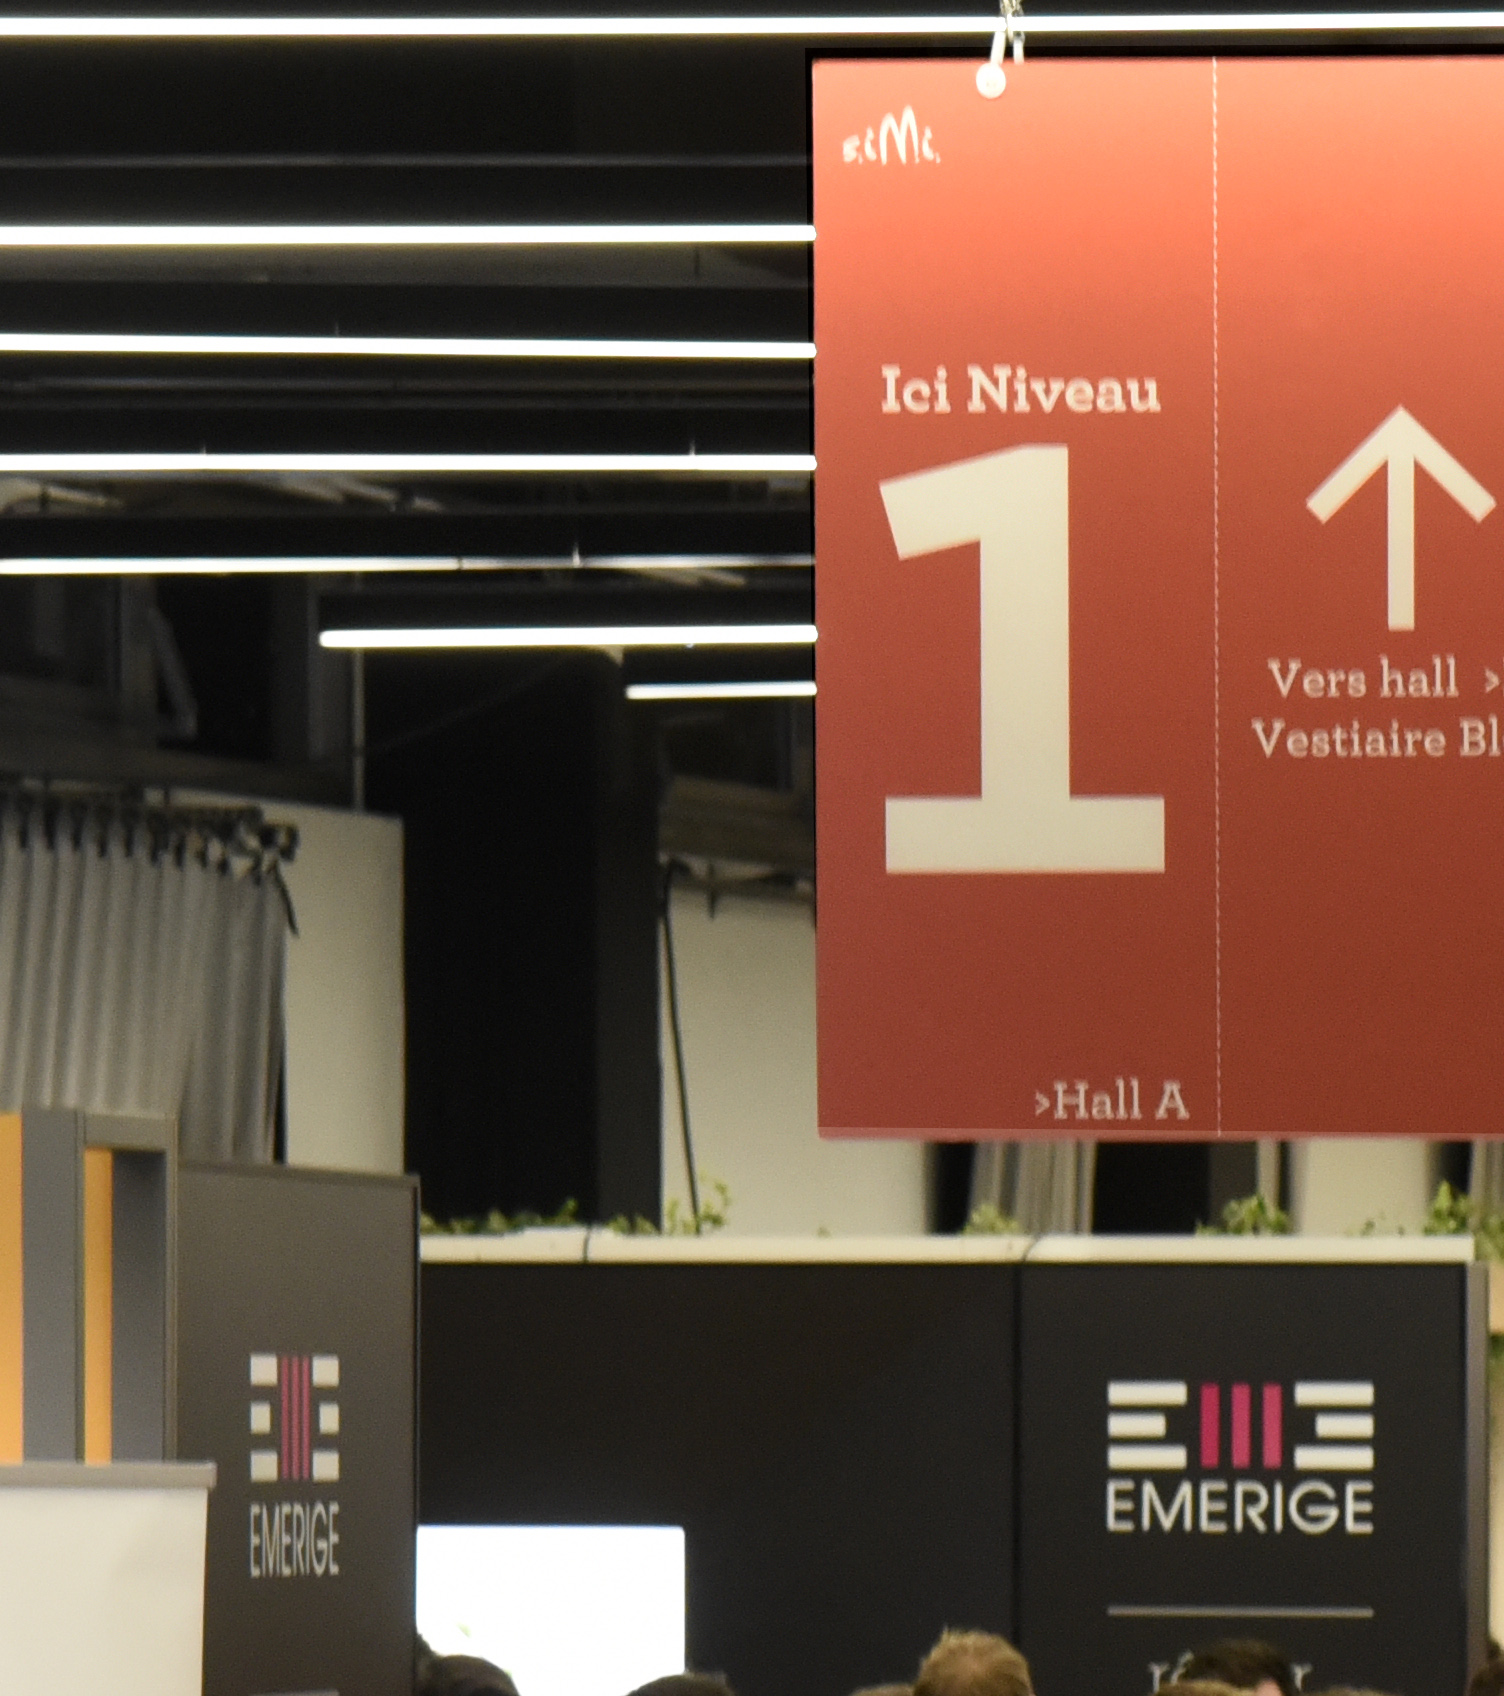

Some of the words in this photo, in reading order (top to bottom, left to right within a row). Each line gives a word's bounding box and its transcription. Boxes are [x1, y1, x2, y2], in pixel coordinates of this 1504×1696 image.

[881, 364, 952, 413] Ici
[966, 364, 1162, 413] Niveau
[879, 443, 1165, 873] 1
[1267, 659, 1366, 698] Vers
[1379, 654, 1459, 698] hall
[1252, 719, 1447, 757] Vestiaire
[1156, 1081, 1189, 1119] A
[1106, 1478, 1374, 1534] EMERIGE
[248, 1499, 341, 1579] EMERIGE
